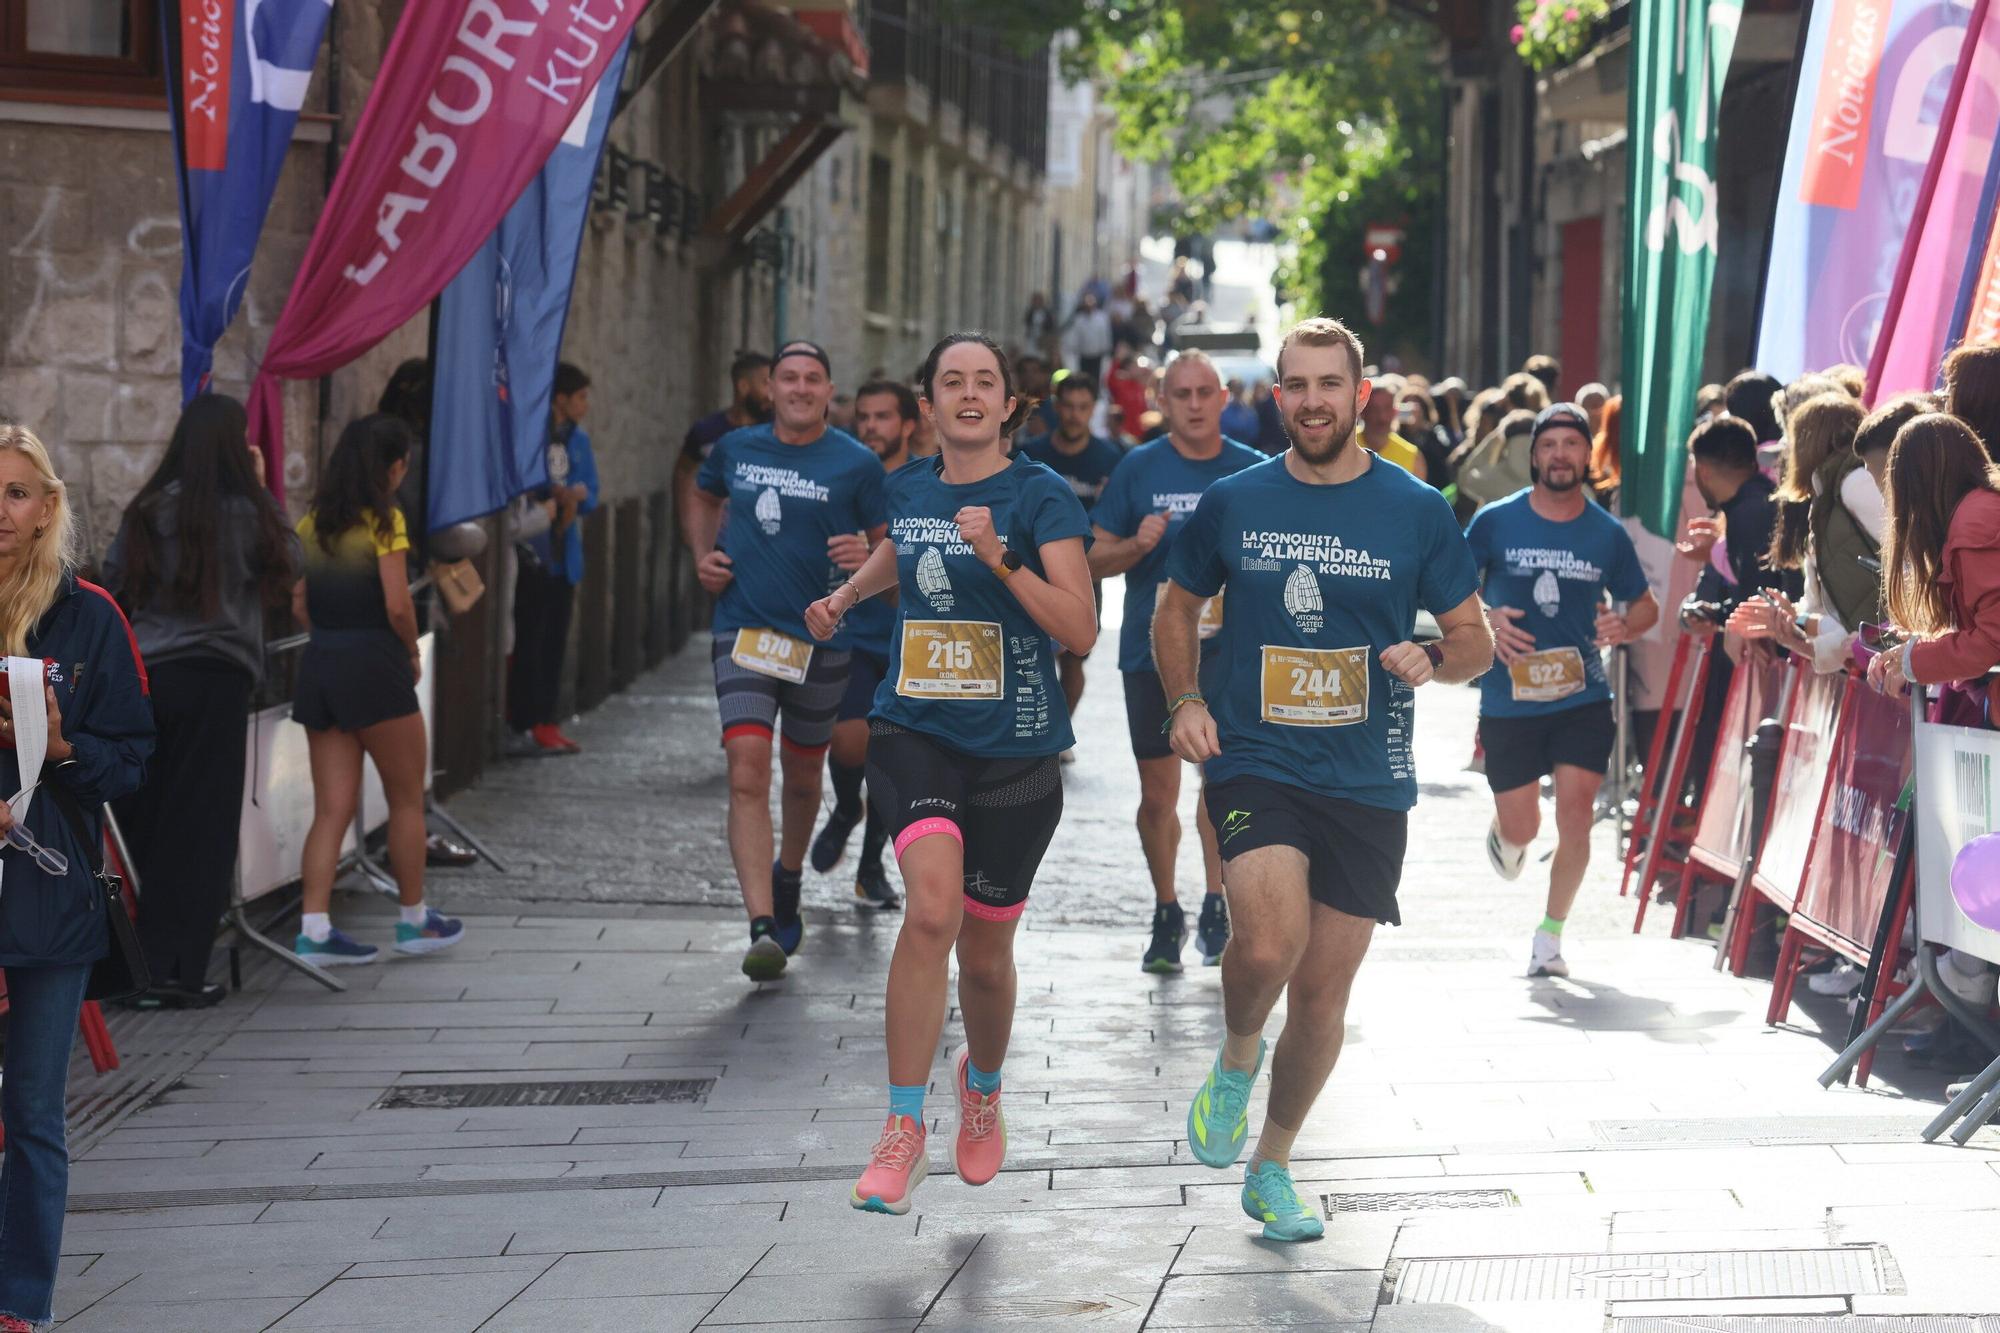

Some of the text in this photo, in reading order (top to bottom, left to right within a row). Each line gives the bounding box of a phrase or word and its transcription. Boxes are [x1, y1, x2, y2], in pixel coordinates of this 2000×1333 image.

[893, 518, 905, 529] LA
[1242, 530, 1342, 548] LA CONQUISTA
[1242, 541, 1252, 549] DE
[1260, 543, 1391, 568] ALMENDRA REN
[1319, 562, 1392, 581] KONKISTA
[1295, 613, 1324, 622] VITORIA
[1295, 620, 1324, 629] GASTEIZ
[927, 640, 973, 669] 215
[1290, 667, 1342, 697] 244
[1529, 662, 1565, 684] 522
